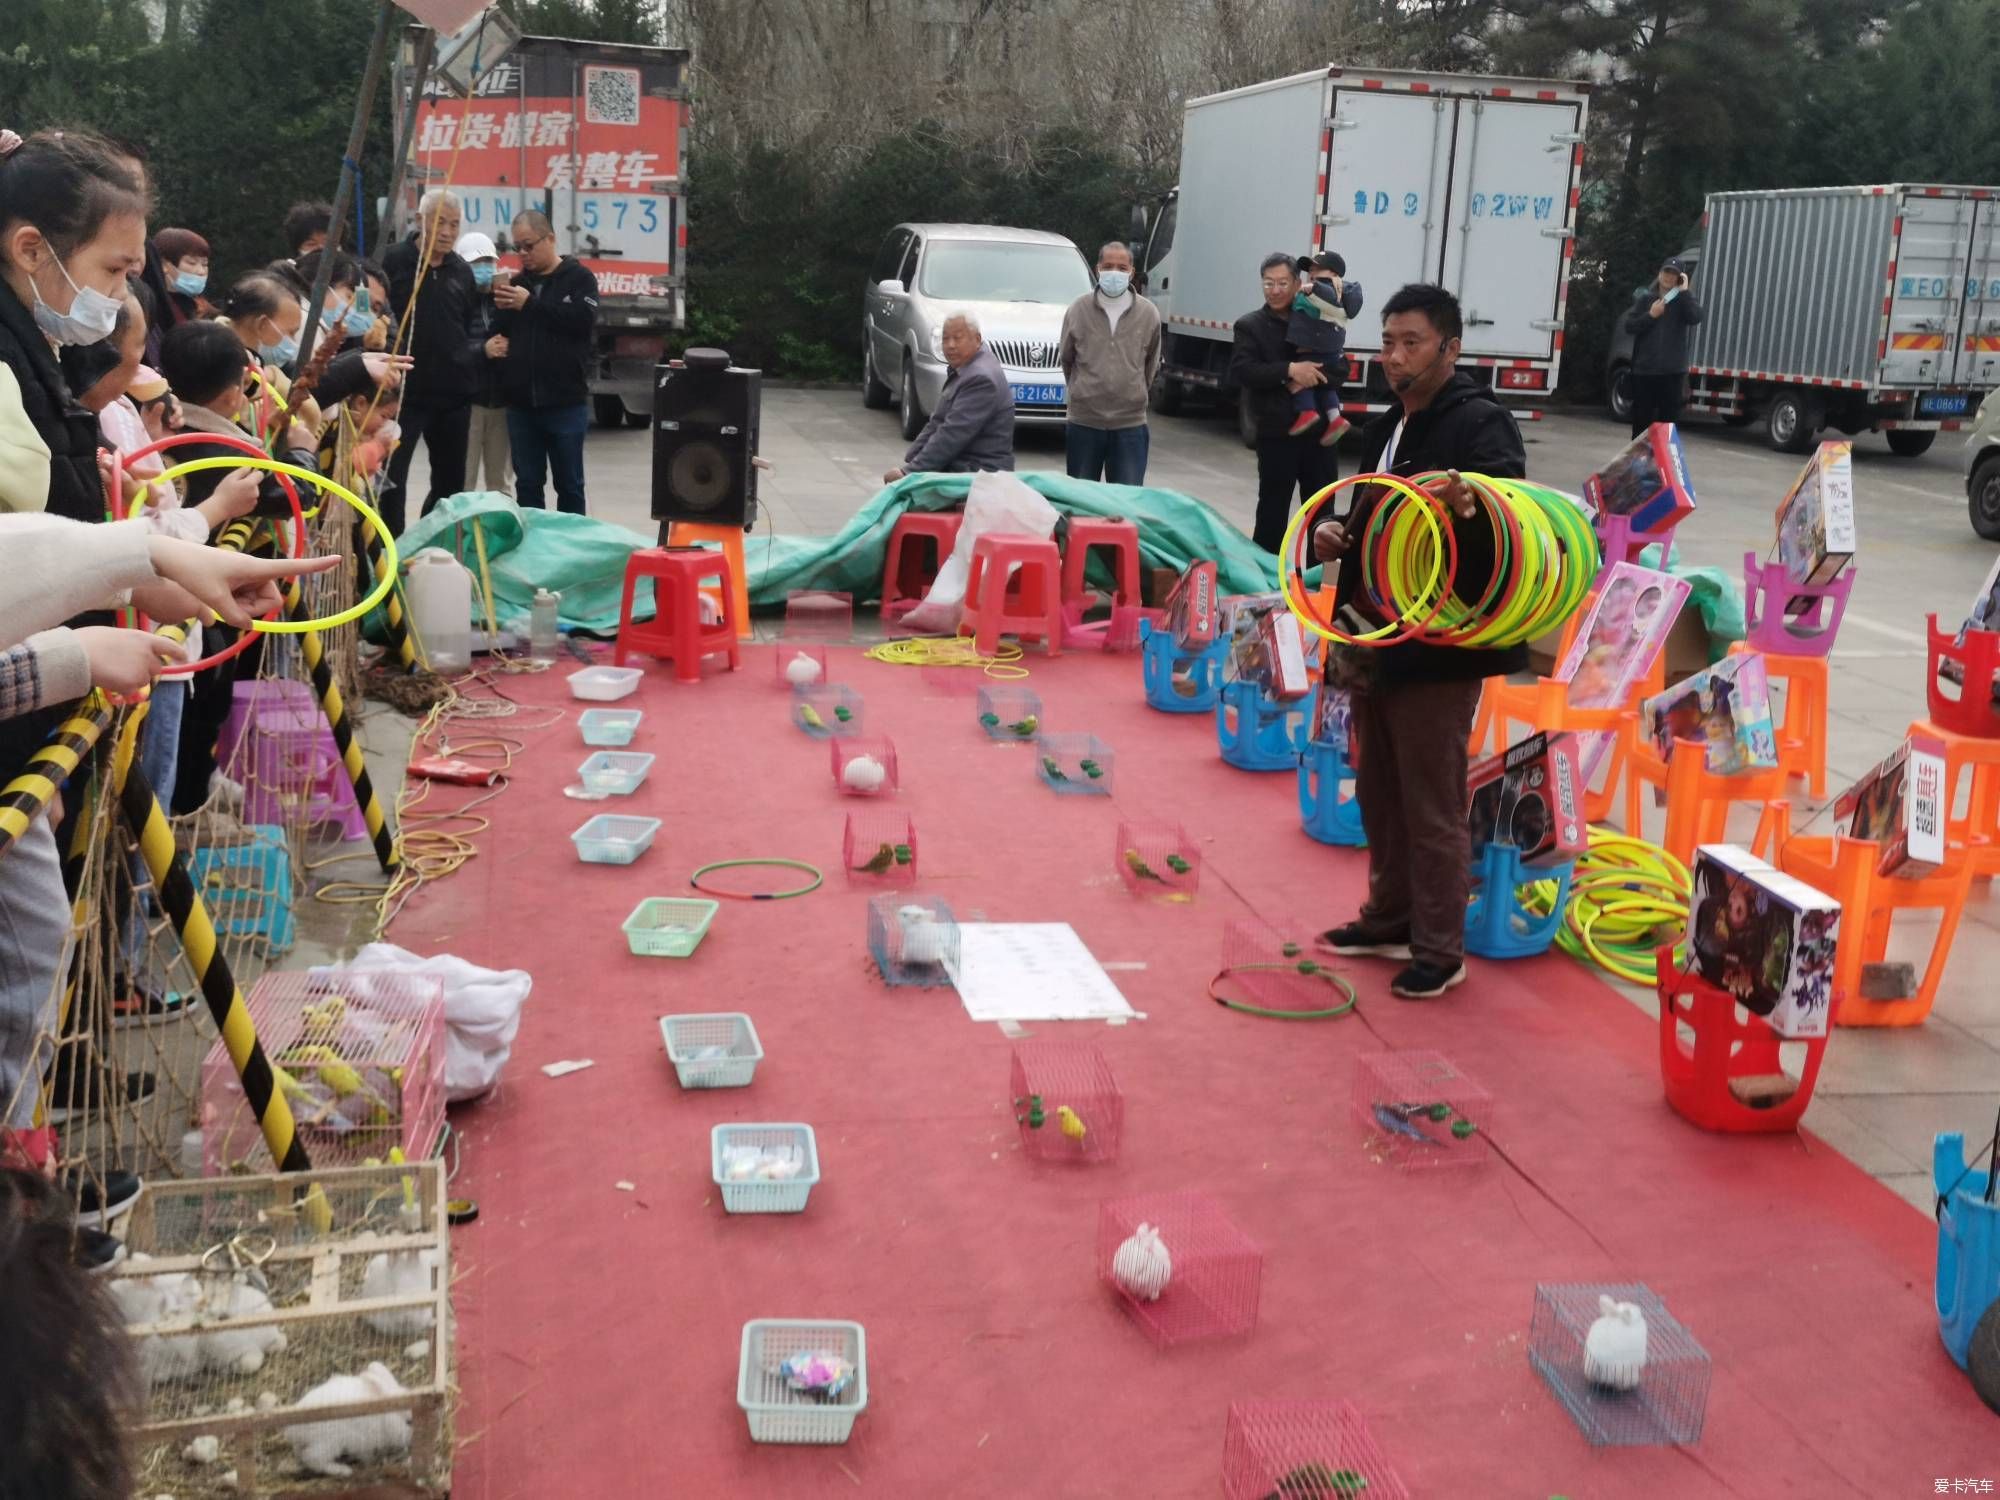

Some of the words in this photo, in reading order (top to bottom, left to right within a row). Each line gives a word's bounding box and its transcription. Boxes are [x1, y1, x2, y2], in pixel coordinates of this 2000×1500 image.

[544, 150, 659, 190] 发整车
[583, 199, 658, 233] 573
